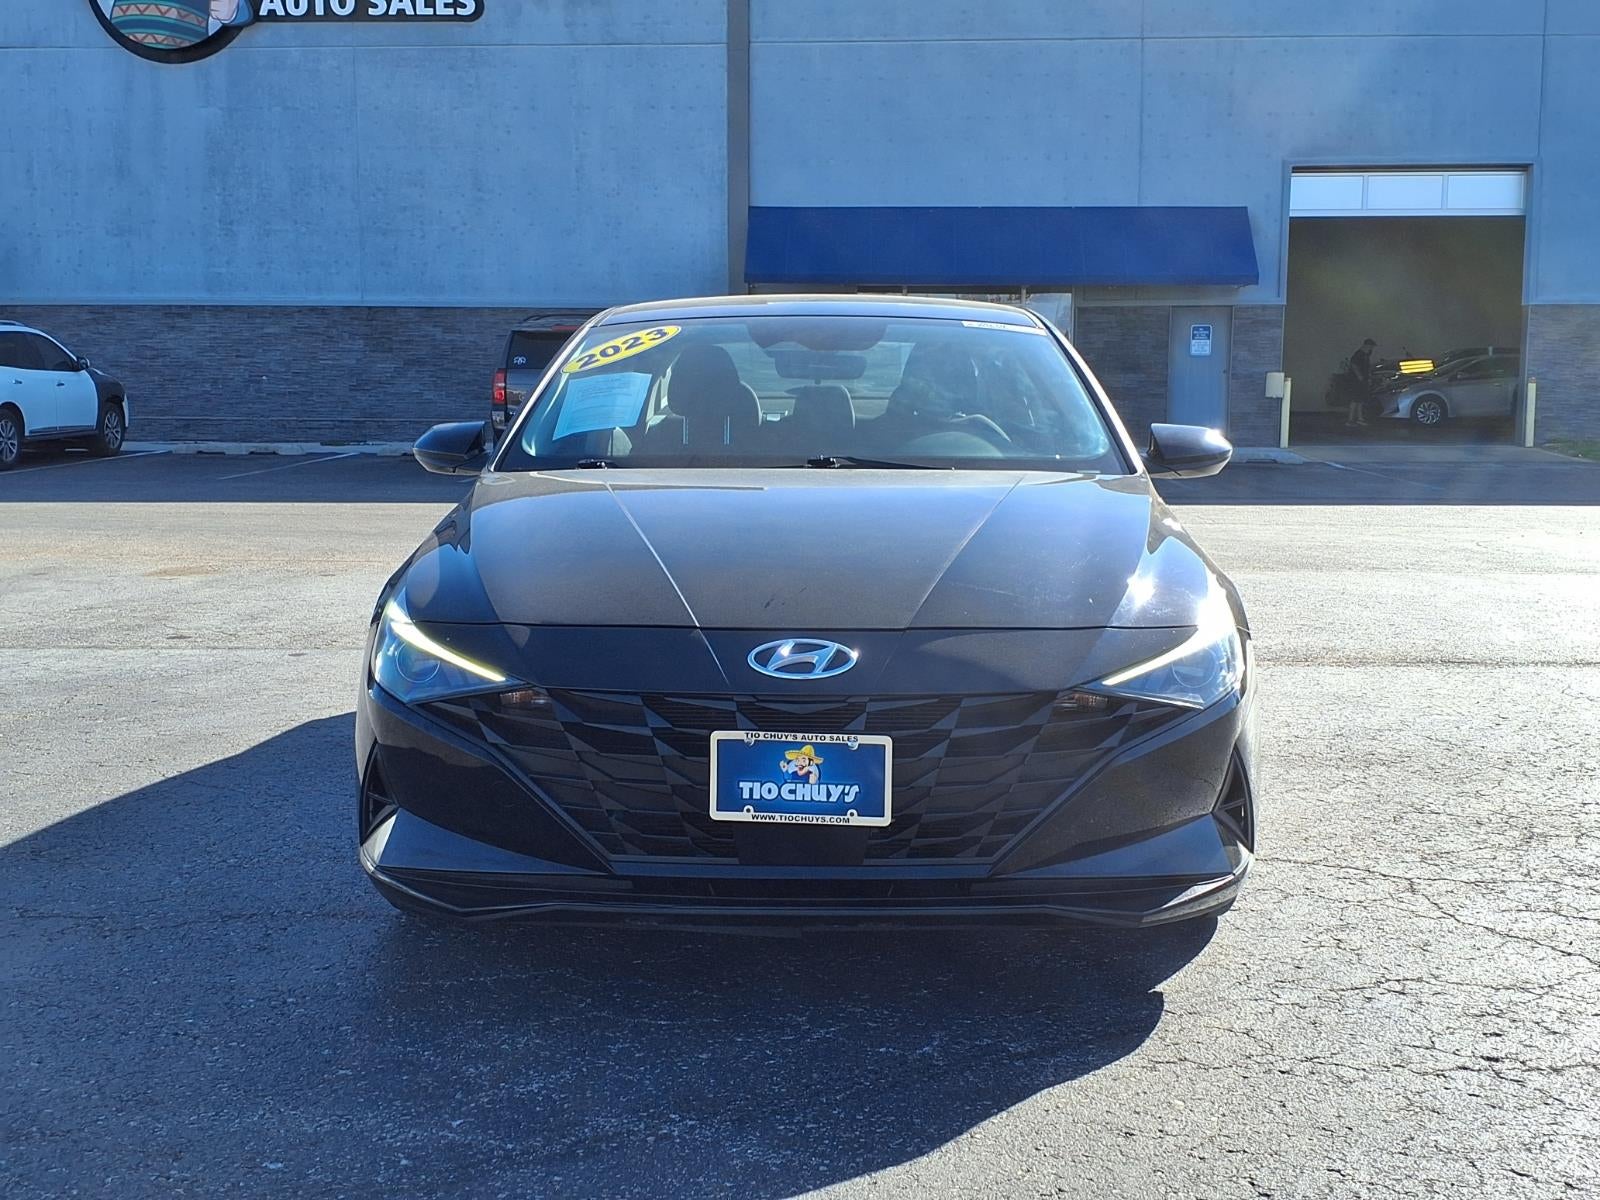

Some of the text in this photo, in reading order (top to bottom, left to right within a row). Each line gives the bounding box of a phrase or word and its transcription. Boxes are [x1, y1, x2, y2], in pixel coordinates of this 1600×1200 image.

[259, 0, 477, 16] AUTO SALES
[575, 327, 669, 369] 2023
[763, 733, 798, 741] CHUY'S
[801, 734, 826, 742] AUTO
[829, 735, 859, 743] SALES
[751, 813, 850, 824] WWW.TIOCHUYS.COM
